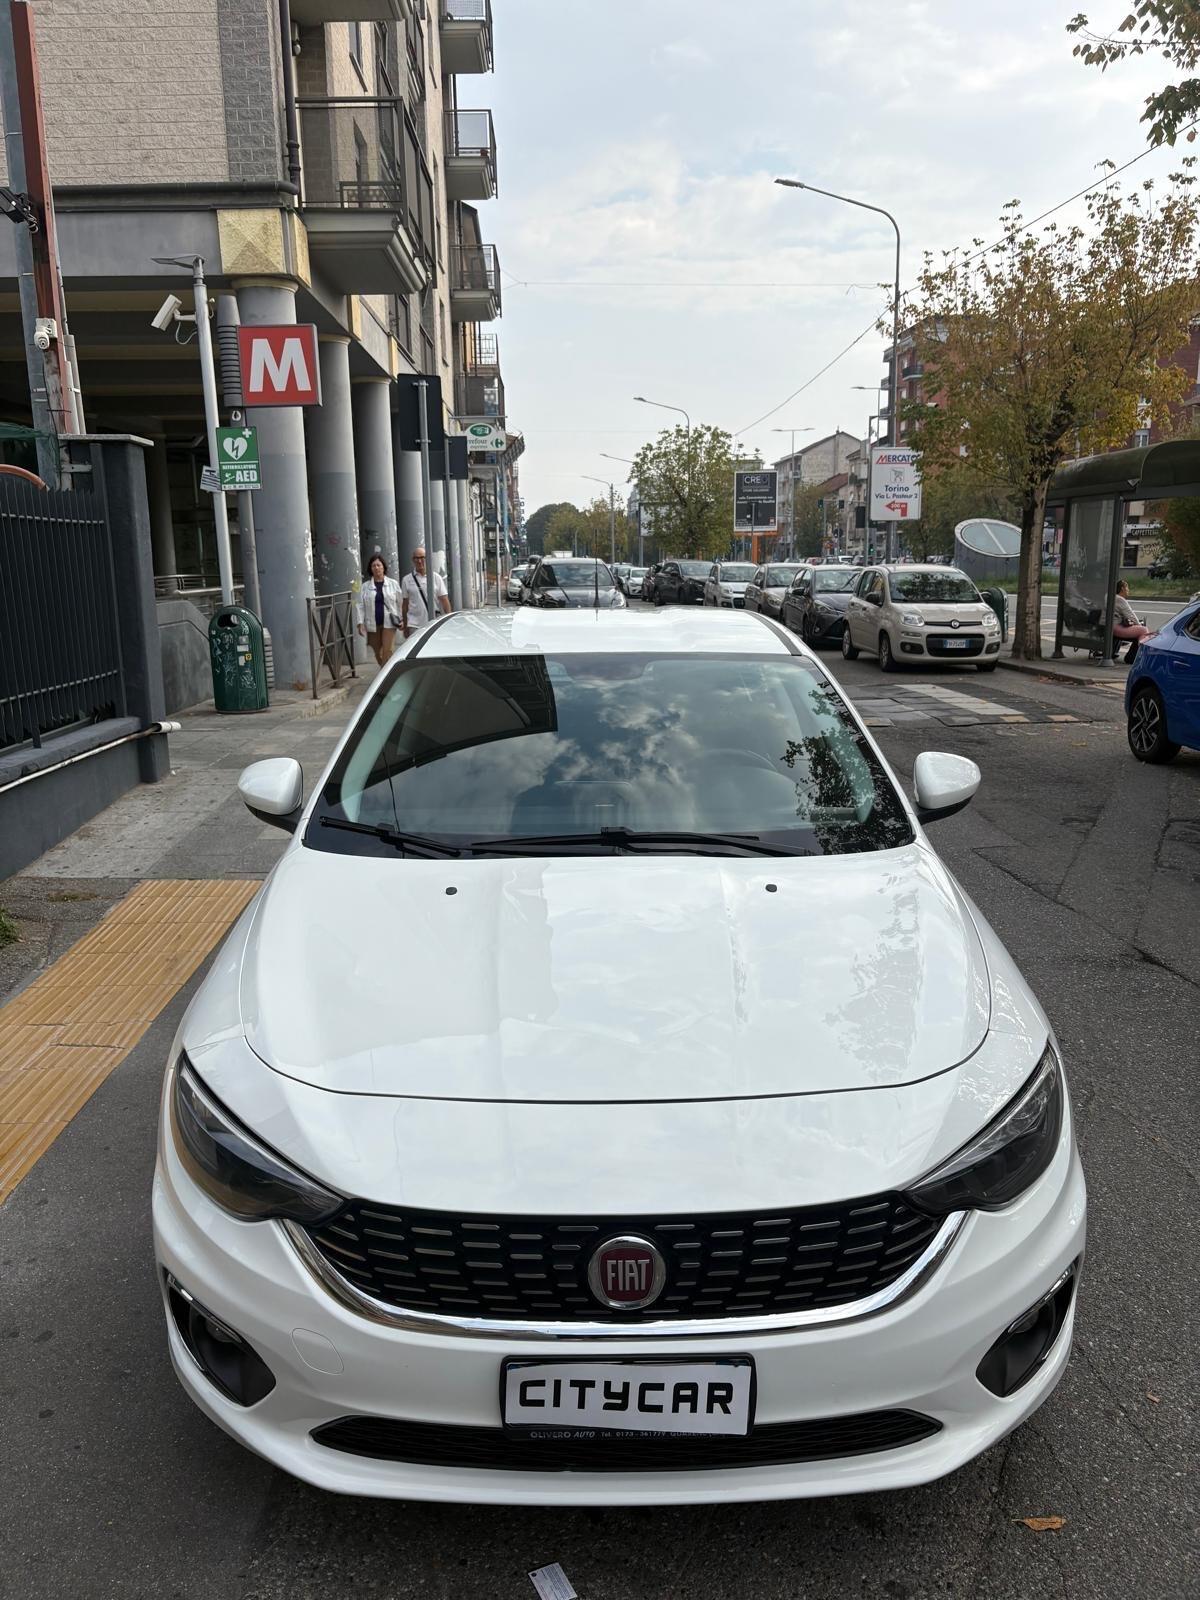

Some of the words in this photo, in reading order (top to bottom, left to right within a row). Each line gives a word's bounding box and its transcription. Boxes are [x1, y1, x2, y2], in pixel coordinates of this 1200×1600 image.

[249, 338, 312, 392] M
[235, 470, 258, 482] AED
[884, 484, 910, 492] Torino
[606, 1258, 651, 1291] FIAT
[519, 1379, 734, 1415] CITYCAR
[530, 1431, 571, 1439] OLIVERO
